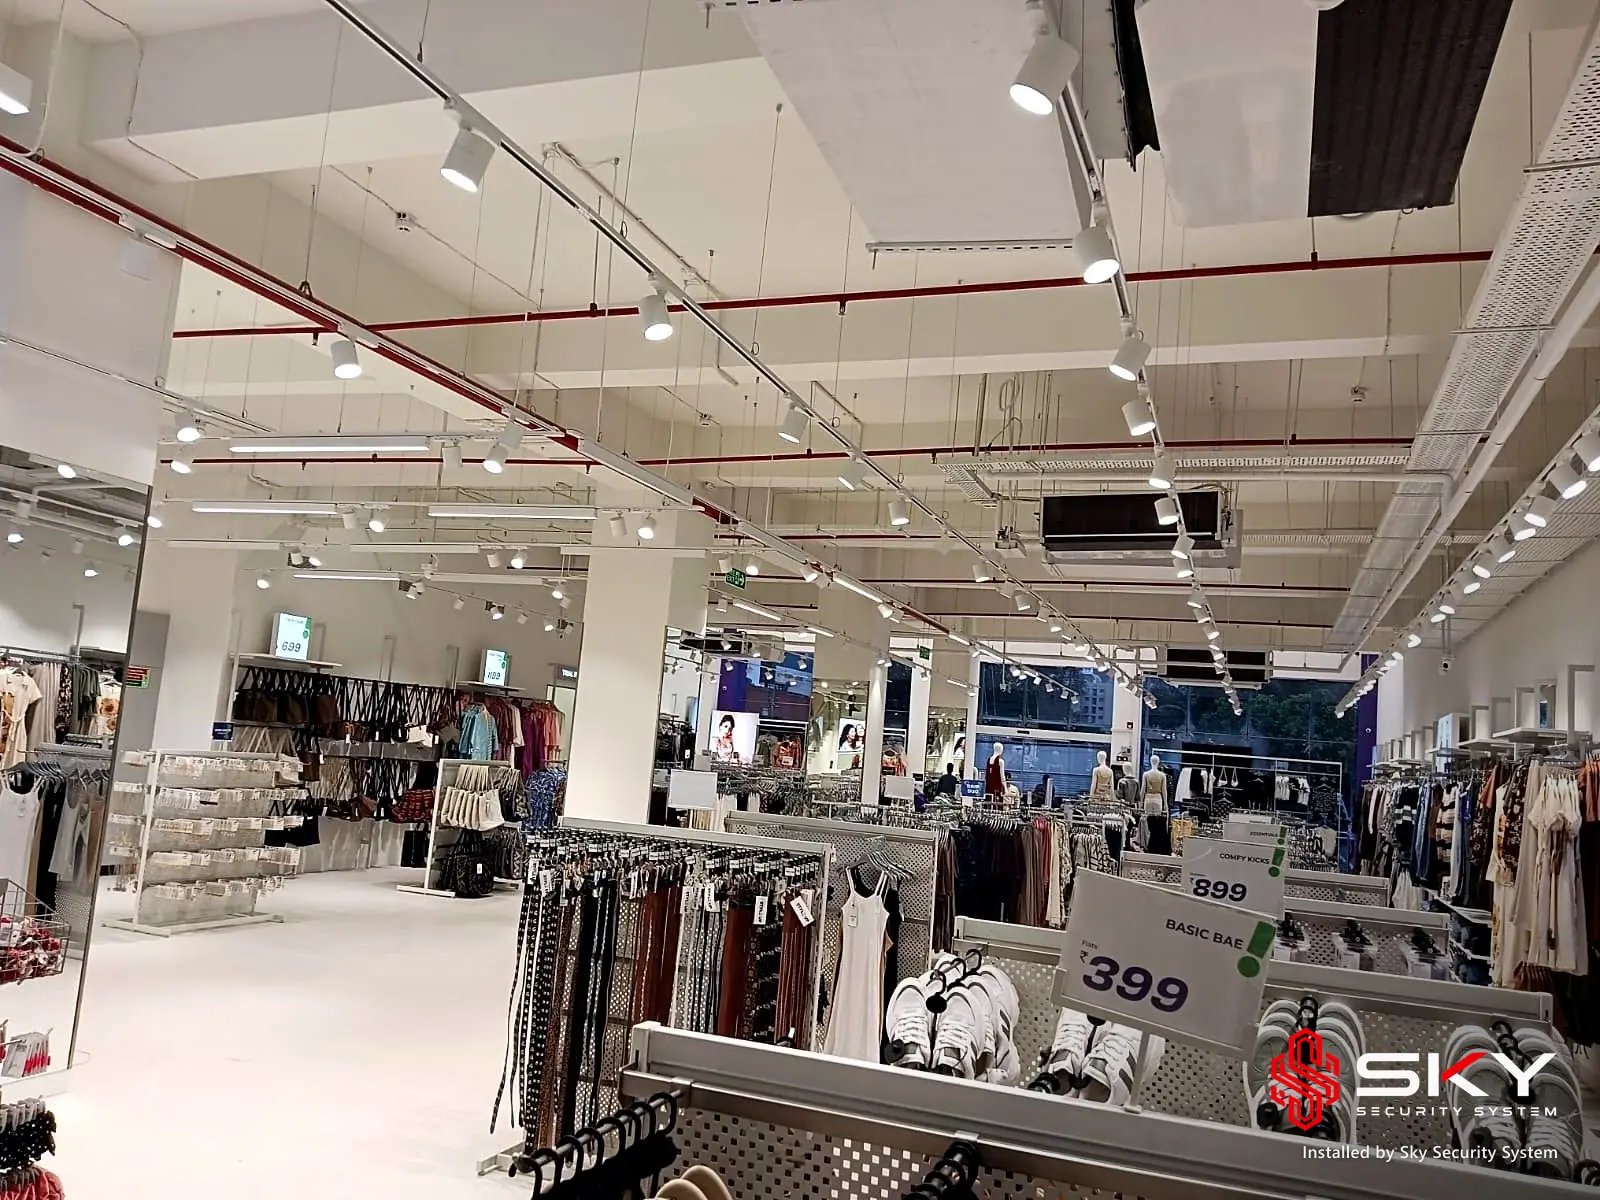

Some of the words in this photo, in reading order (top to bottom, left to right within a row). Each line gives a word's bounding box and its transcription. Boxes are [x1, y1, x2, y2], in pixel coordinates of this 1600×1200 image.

[281, 641, 301, 652] 699
[1219, 853, 1246, 862] COMFY
[1247, 856, 1270, 865] KICKS
[1166, 919, 1210, 940] BASIC
[1212, 932, 1245, 950] BAE
